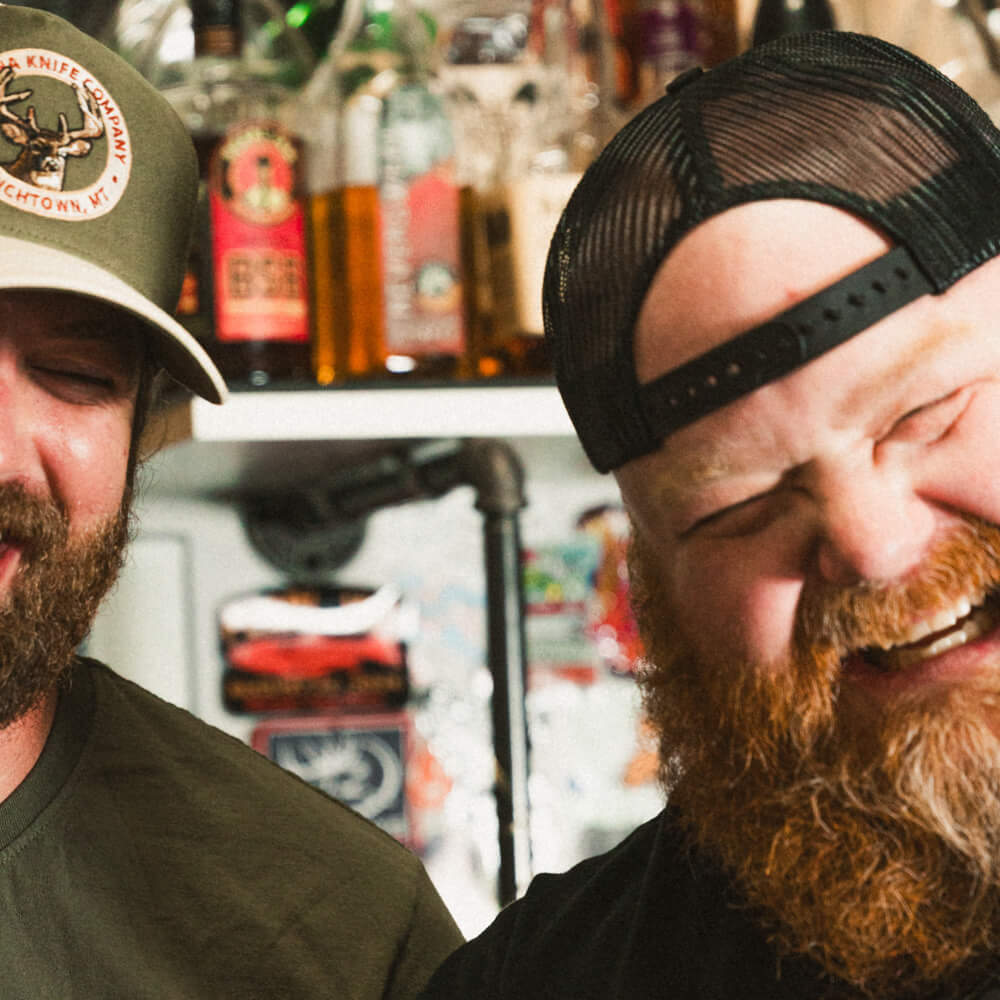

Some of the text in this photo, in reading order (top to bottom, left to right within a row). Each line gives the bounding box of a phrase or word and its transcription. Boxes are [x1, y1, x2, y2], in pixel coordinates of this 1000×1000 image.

[26, 55, 81, 80] KNIFE
[83, 78, 127, 165] COMPANY
[89, 187, 110, 209] MT
